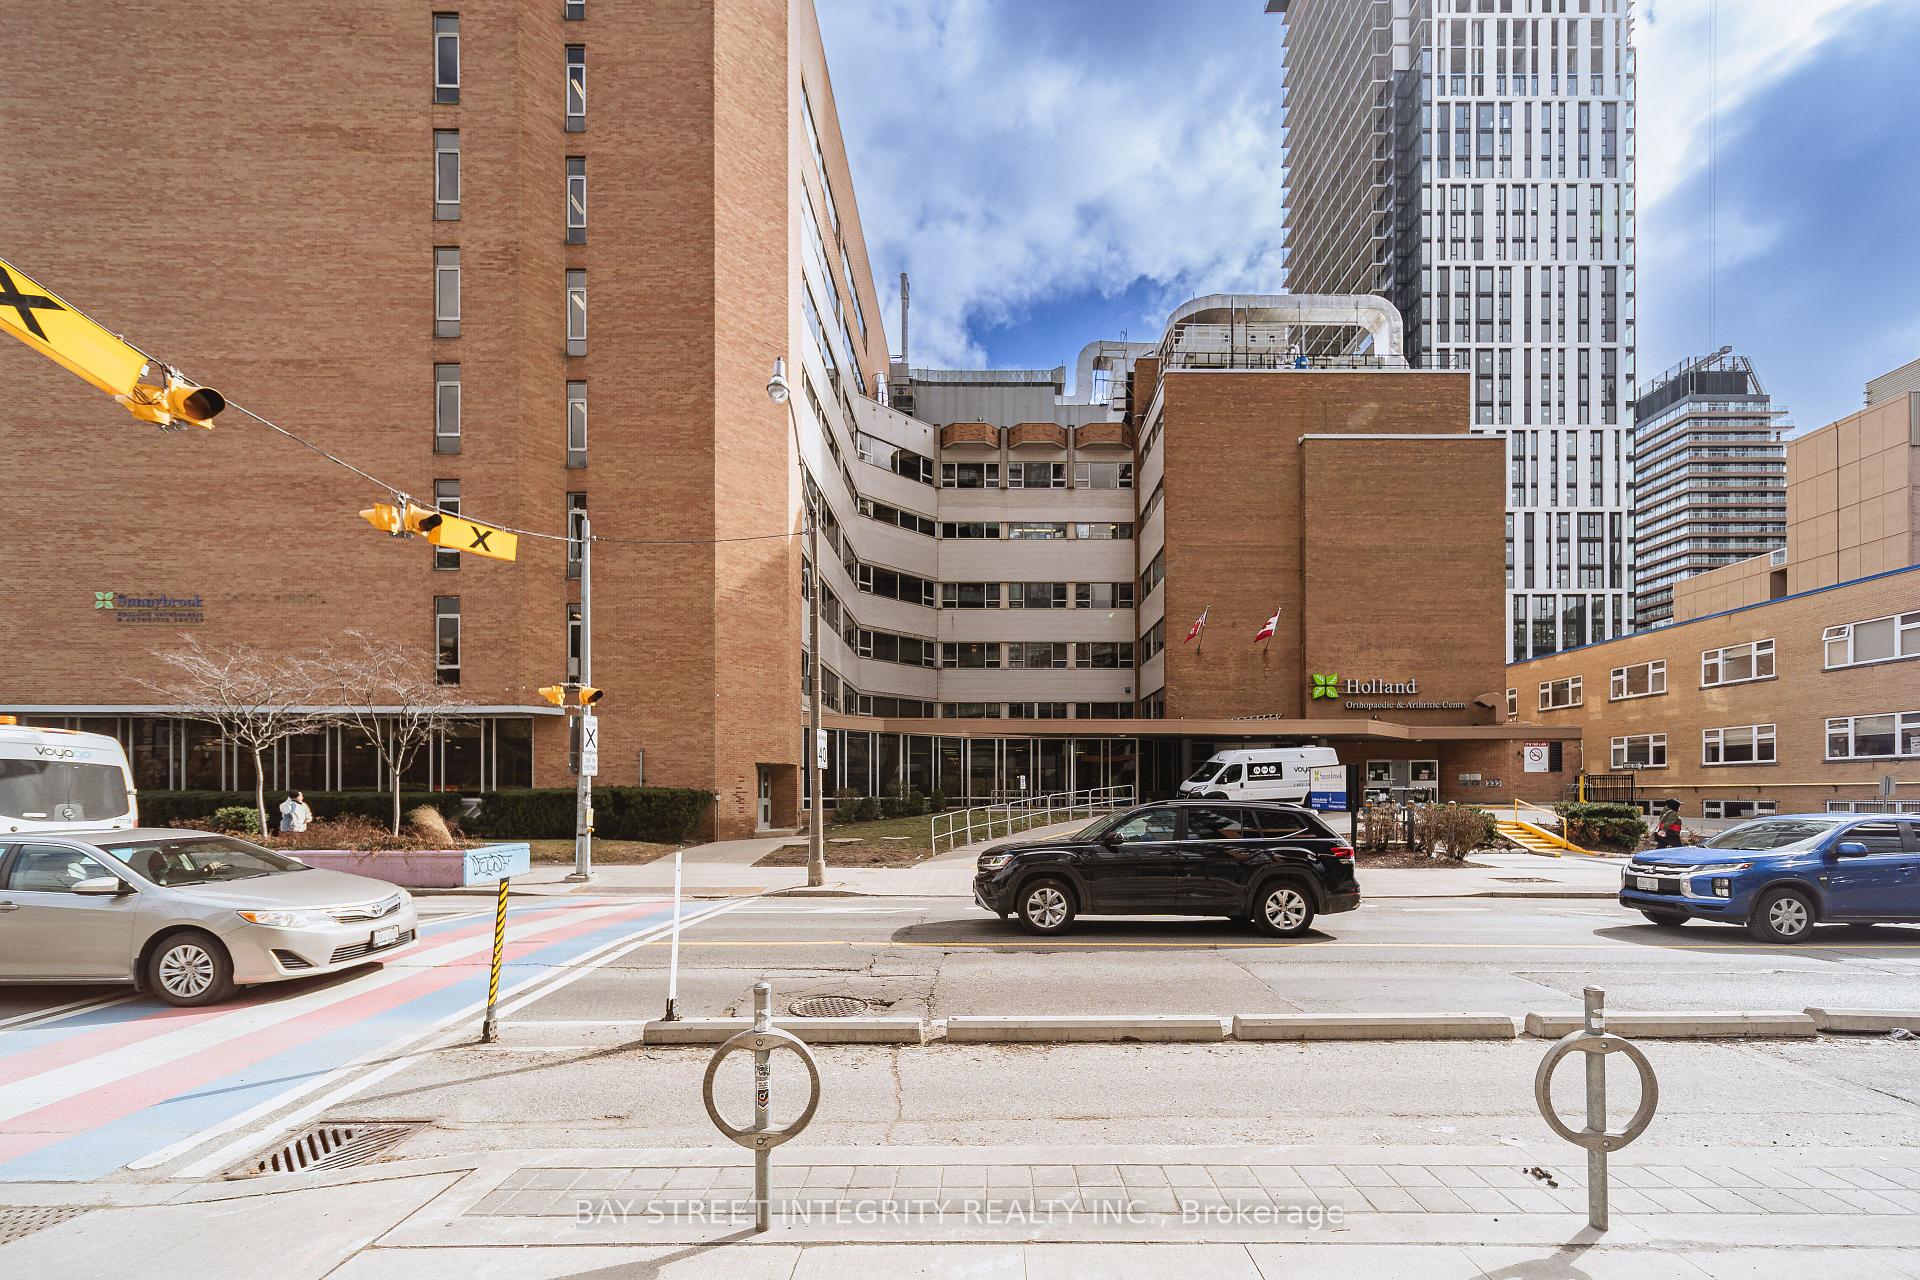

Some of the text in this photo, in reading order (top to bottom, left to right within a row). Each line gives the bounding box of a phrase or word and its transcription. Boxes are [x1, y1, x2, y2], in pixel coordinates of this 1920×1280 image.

[1346, 678, 1417, 694] Holland
[1346, 700, 1392, 710] Orthopaedic
[1442, 701, 1468, 709] Centre
[818, 746, 827, 763] 40
